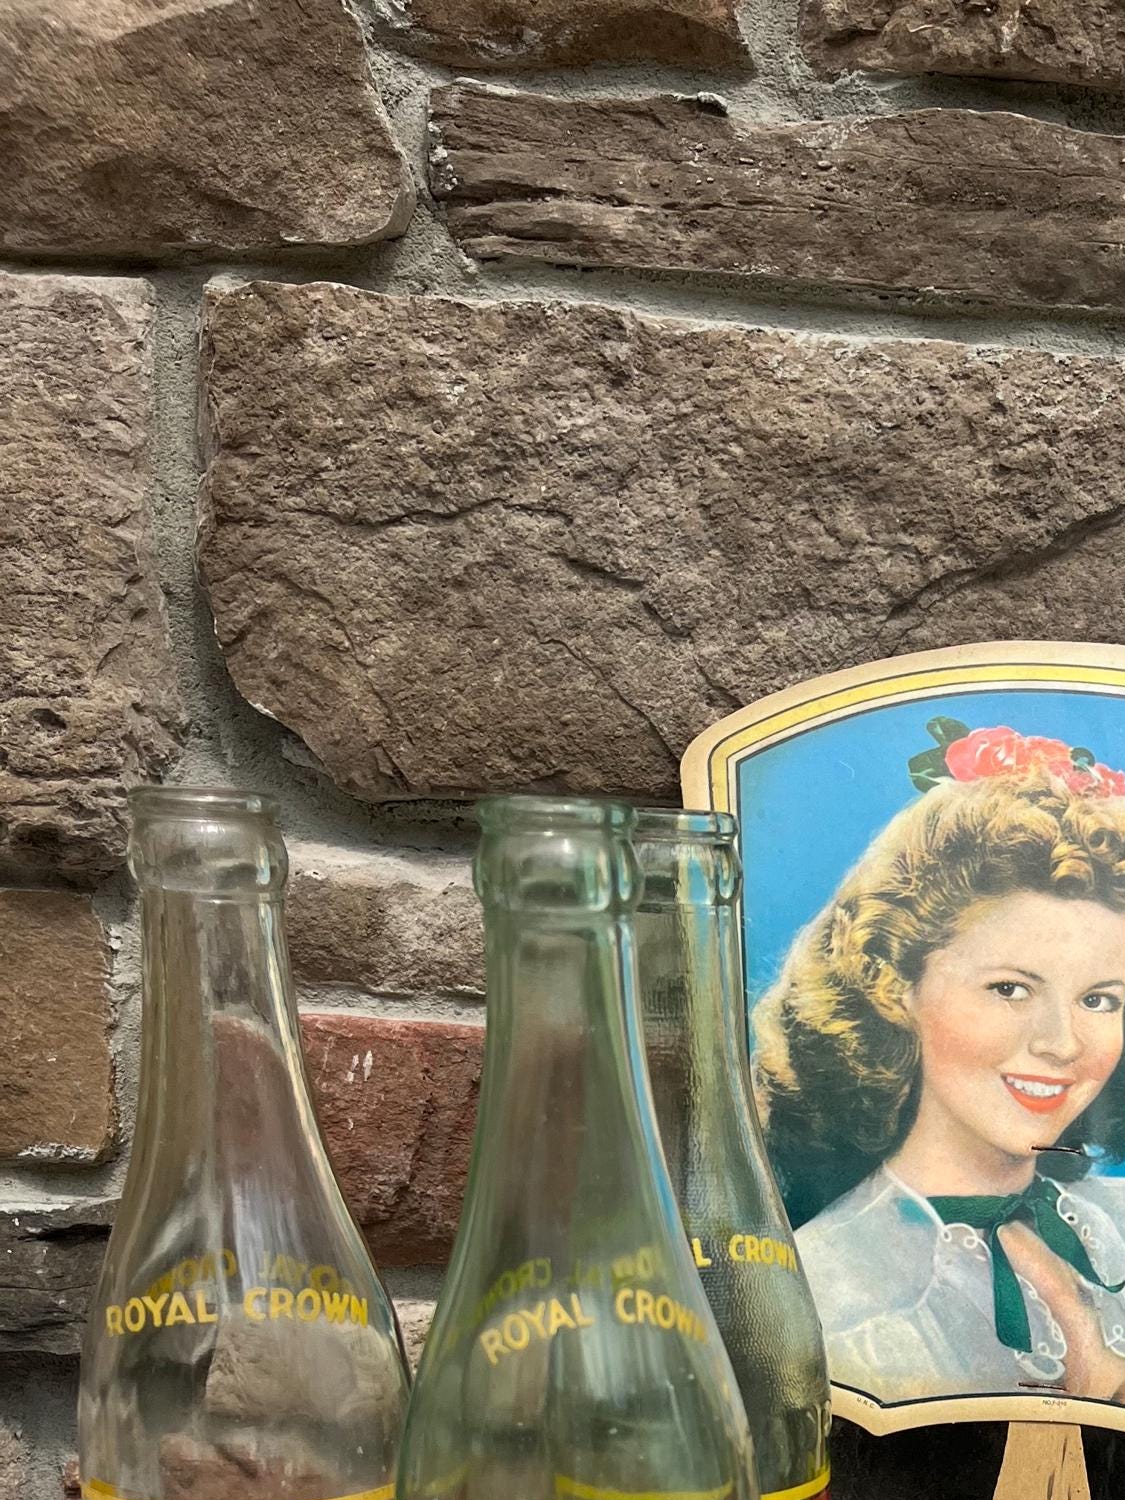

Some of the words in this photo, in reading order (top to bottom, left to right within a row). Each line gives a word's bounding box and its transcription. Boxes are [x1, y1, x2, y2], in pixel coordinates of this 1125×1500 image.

[729, 1234, 798, 1272] CROWN
[105, 1288, 219, 1337] ROYAL
[242, 1287, 369, 1328] CROWN
[479, 1293, 596, 1365] ROYAL
[615, 1287, 708, 1345] CROWN
